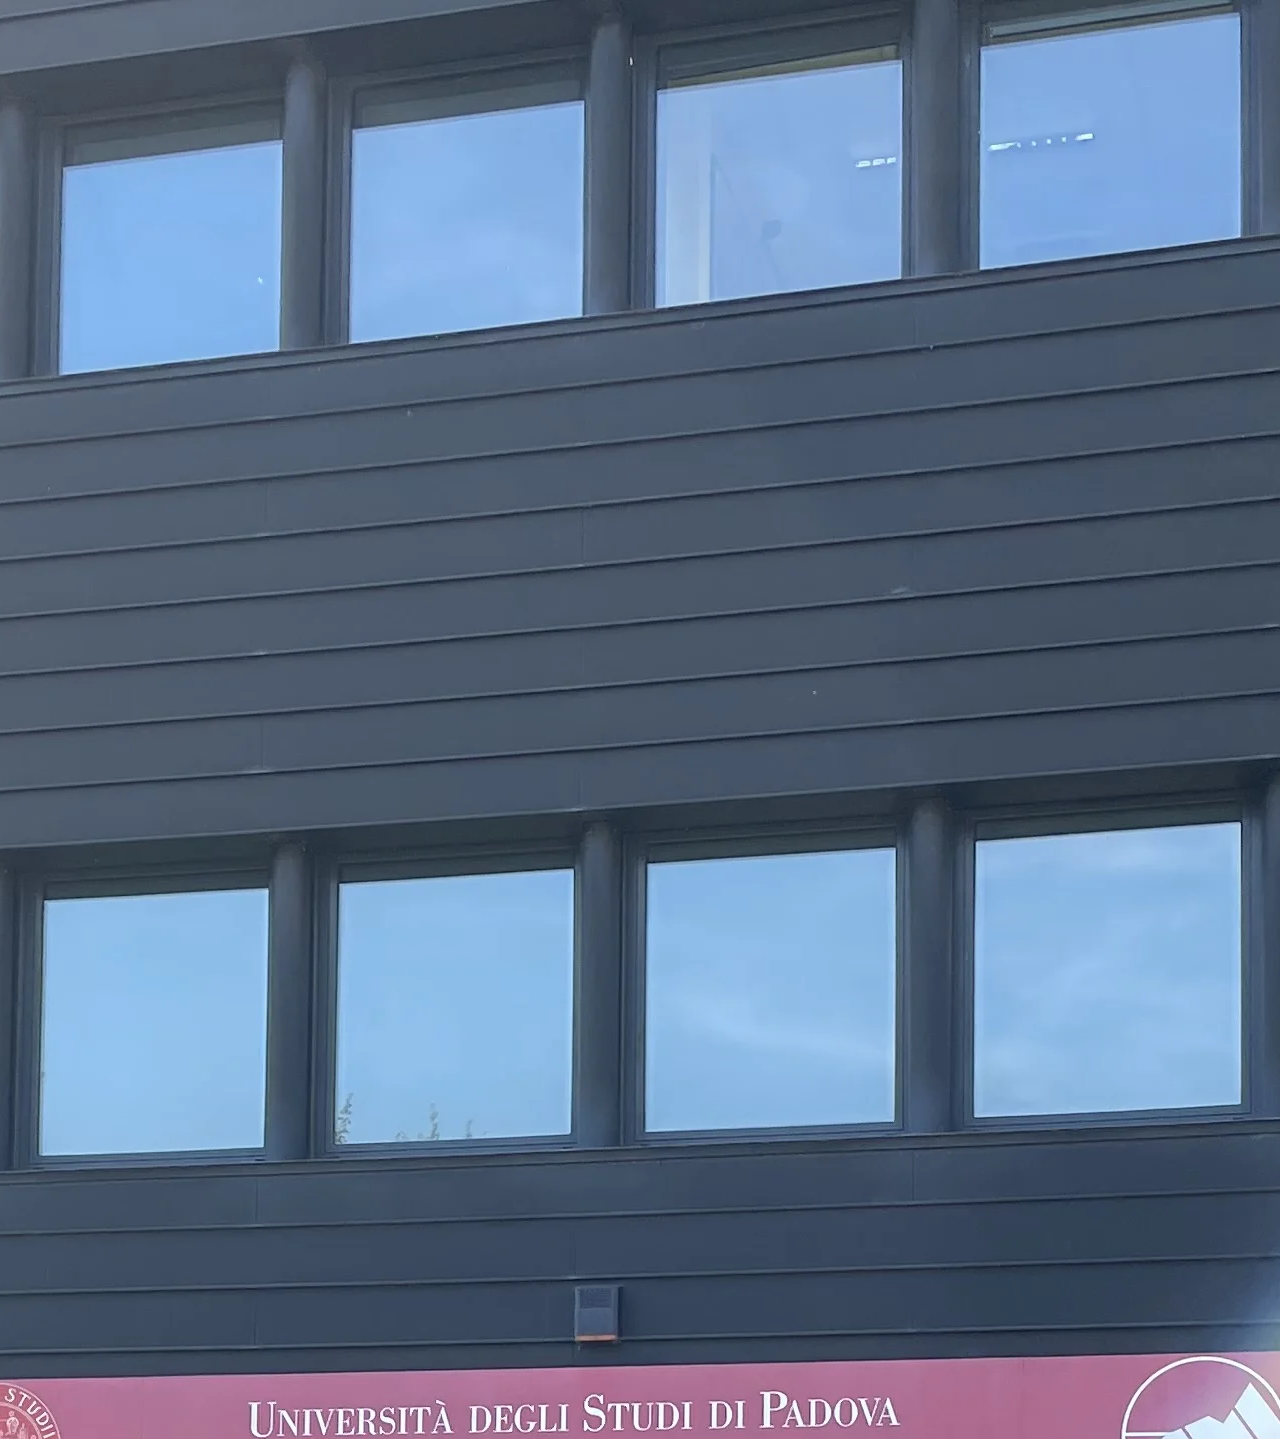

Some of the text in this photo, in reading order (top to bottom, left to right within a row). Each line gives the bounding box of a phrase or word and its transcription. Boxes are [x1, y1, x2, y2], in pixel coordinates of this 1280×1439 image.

[247, 1390, 901, 1439] UNIVERSITÀ DEGLI STUDI DI PADOVA
